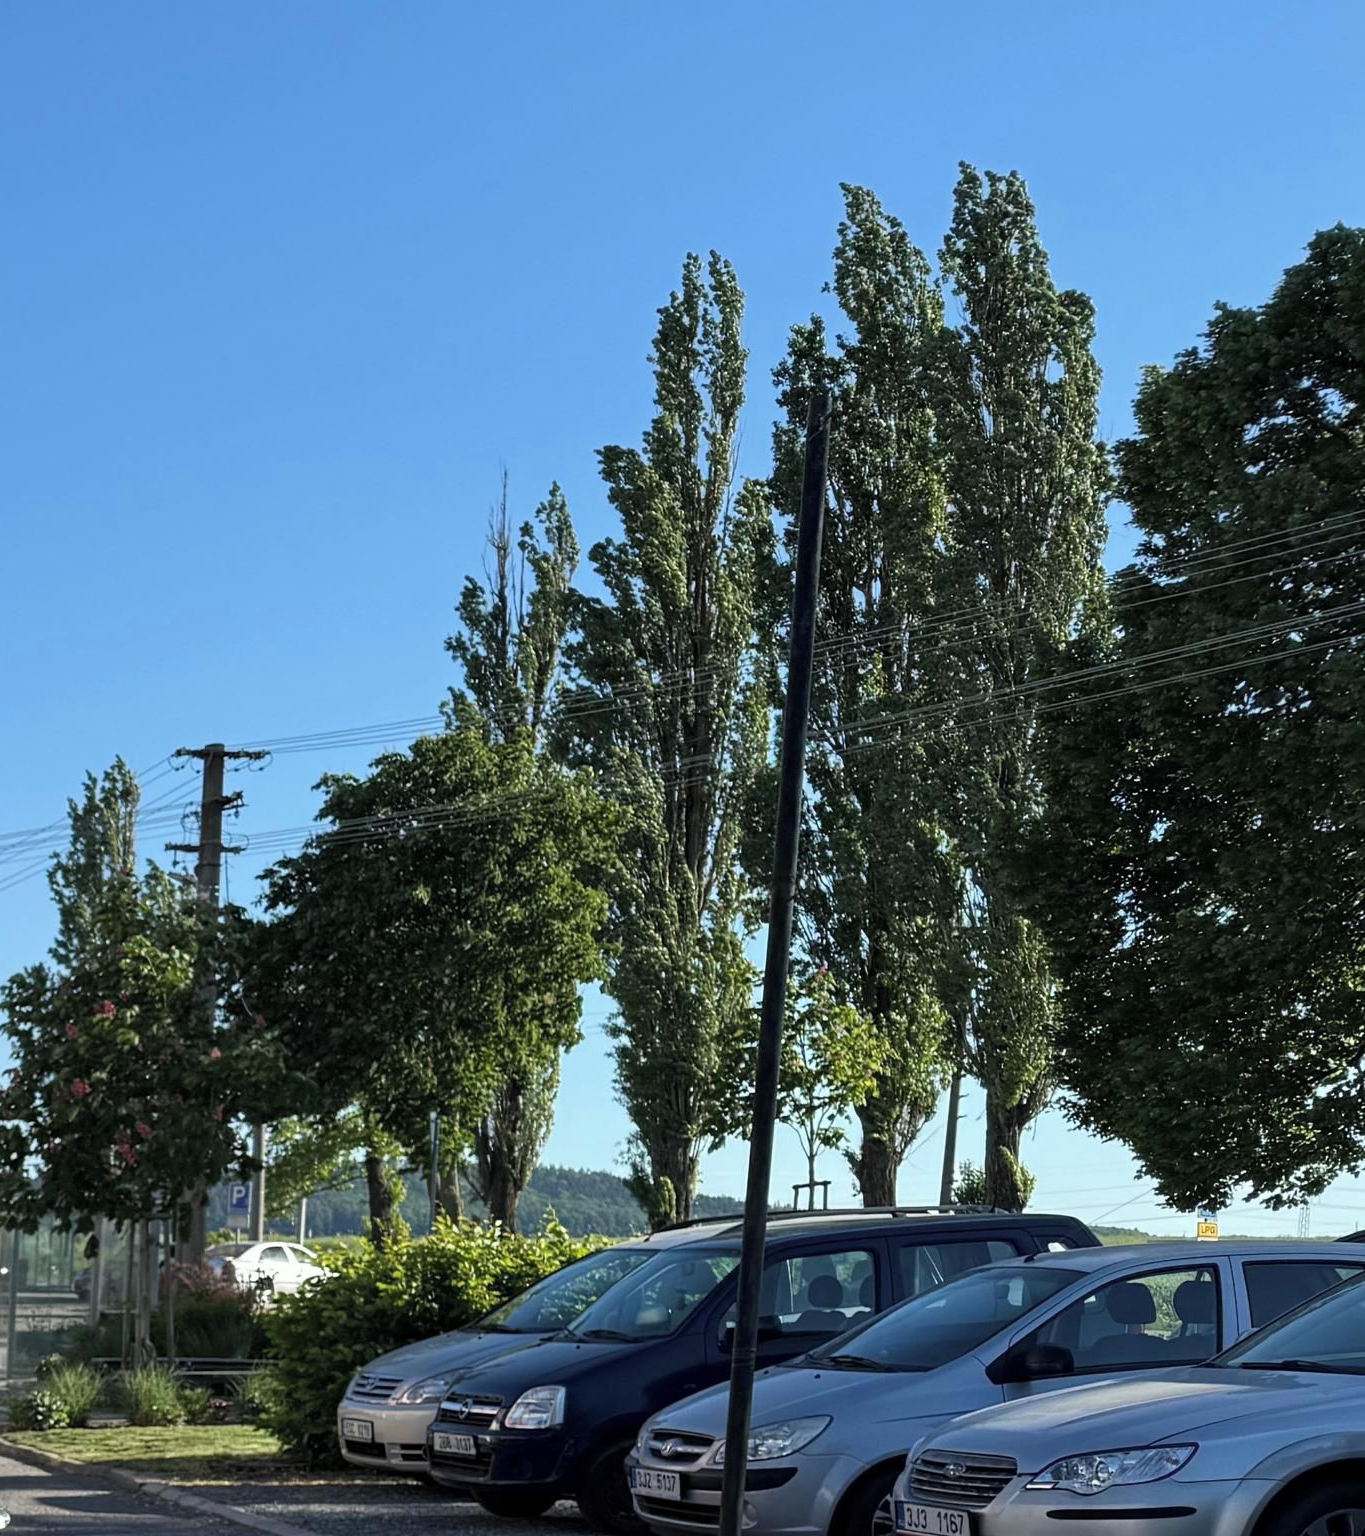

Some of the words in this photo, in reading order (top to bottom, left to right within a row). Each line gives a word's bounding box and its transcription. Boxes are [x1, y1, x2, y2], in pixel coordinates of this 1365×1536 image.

[233, 1186, 246, 1205] P
[1201, 1225, 1216, 1234] LPG
[656, 1473, 676, 1492] 5137
[906, 1507, 928, 1529] 3J3
[937, 1510, 964, 1535] 1167
